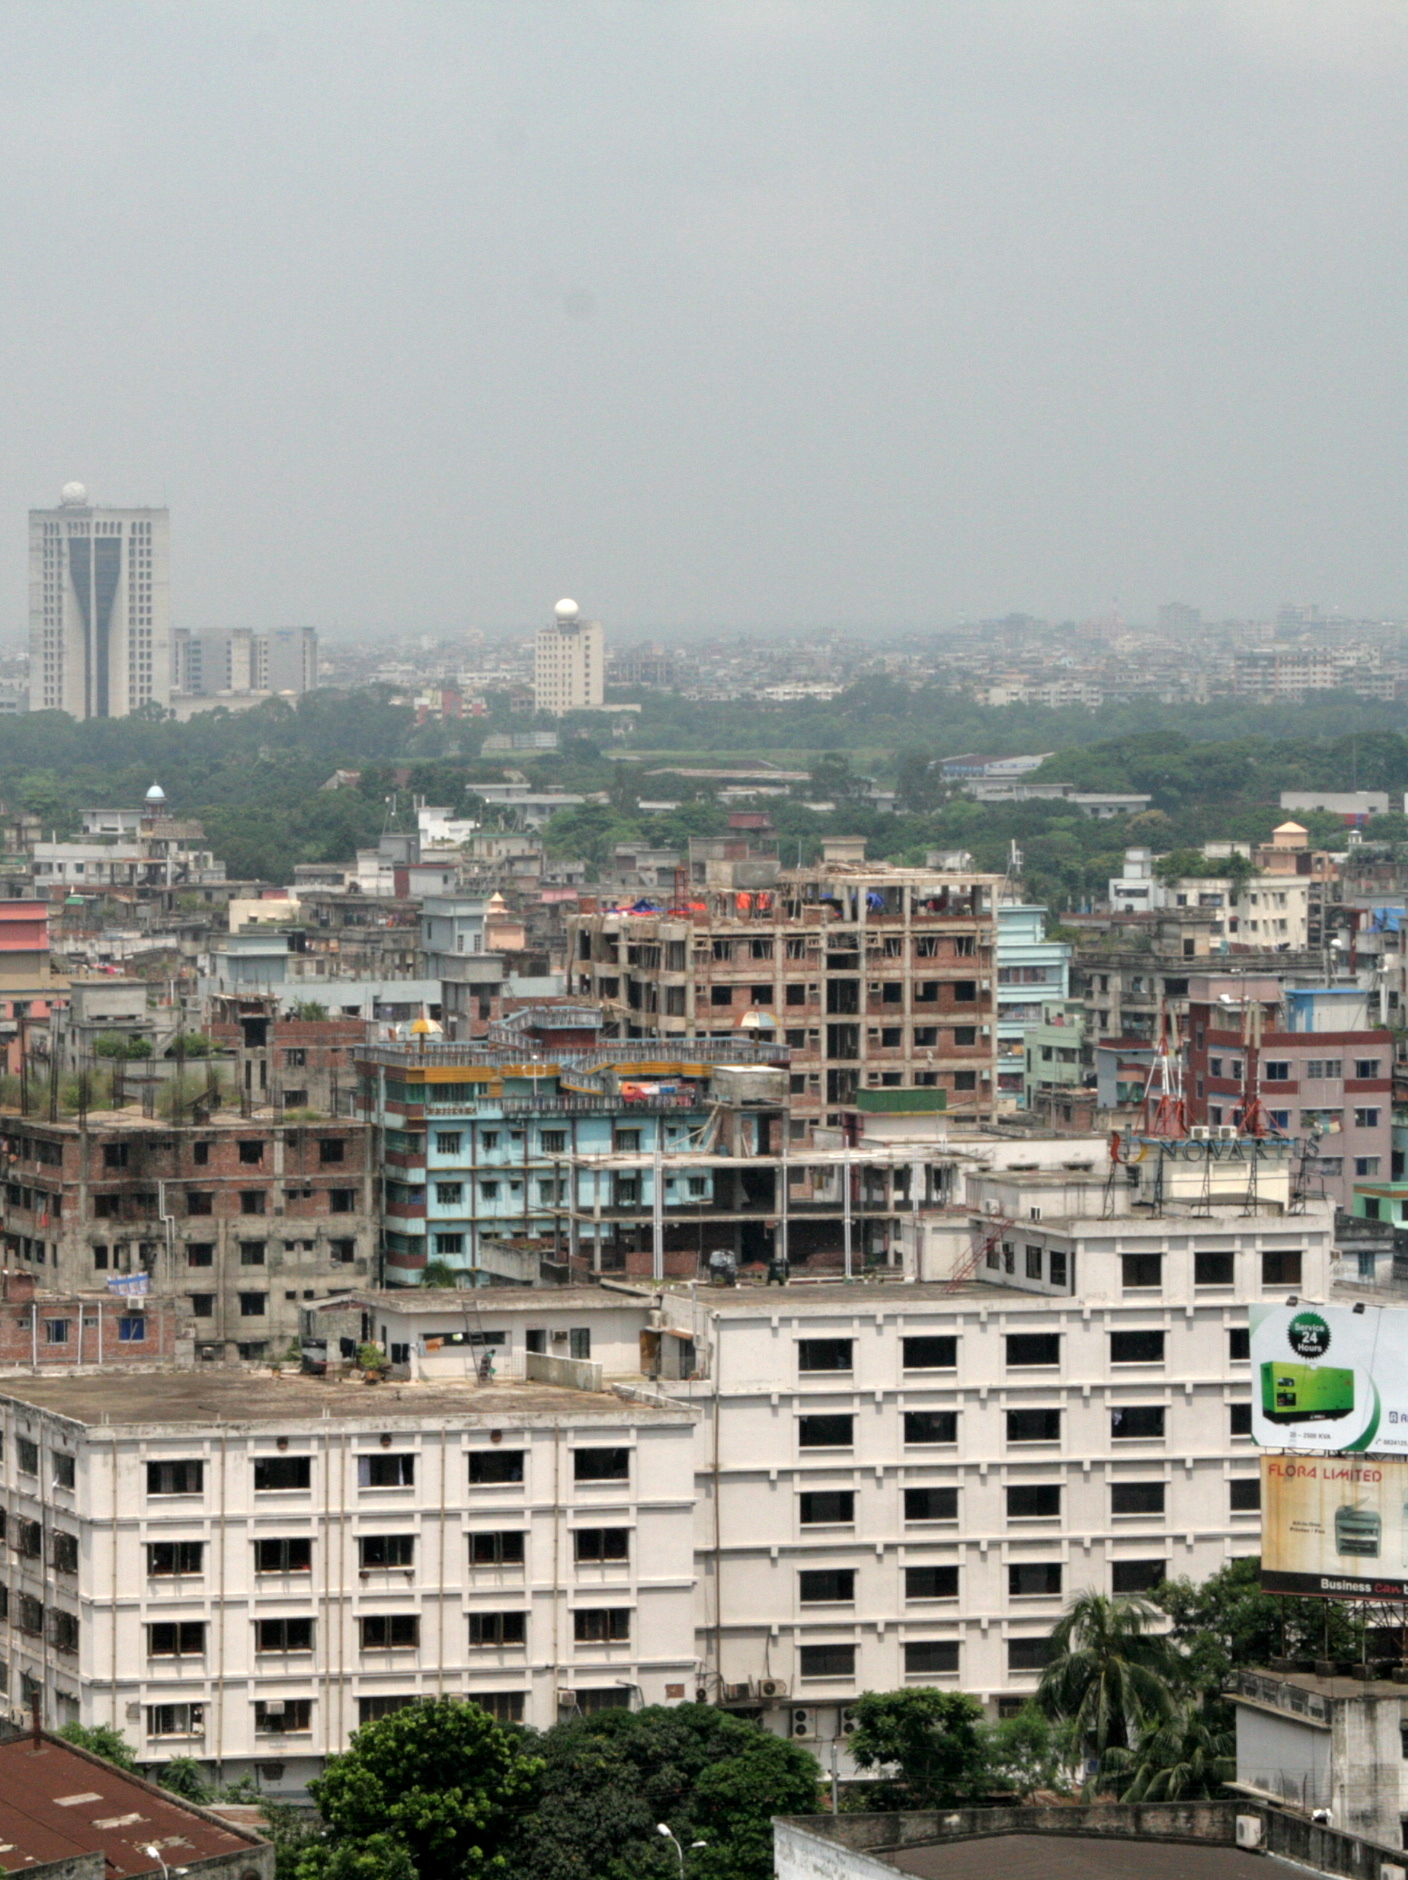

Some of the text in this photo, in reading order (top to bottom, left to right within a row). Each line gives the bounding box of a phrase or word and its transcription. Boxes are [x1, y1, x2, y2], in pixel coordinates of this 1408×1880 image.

[1158, 1136, 1321, 1162] NOVARTIS
[1294, 1322, 1325, 1332] Service
[1301, 1331, 1318, 1344] 24
[1297, 1343, 1323, 1352] Hours
[1268, 1463, 1383, 1483] FLORA LIMITED
[1320, 1578, 1372, 1593] Business
